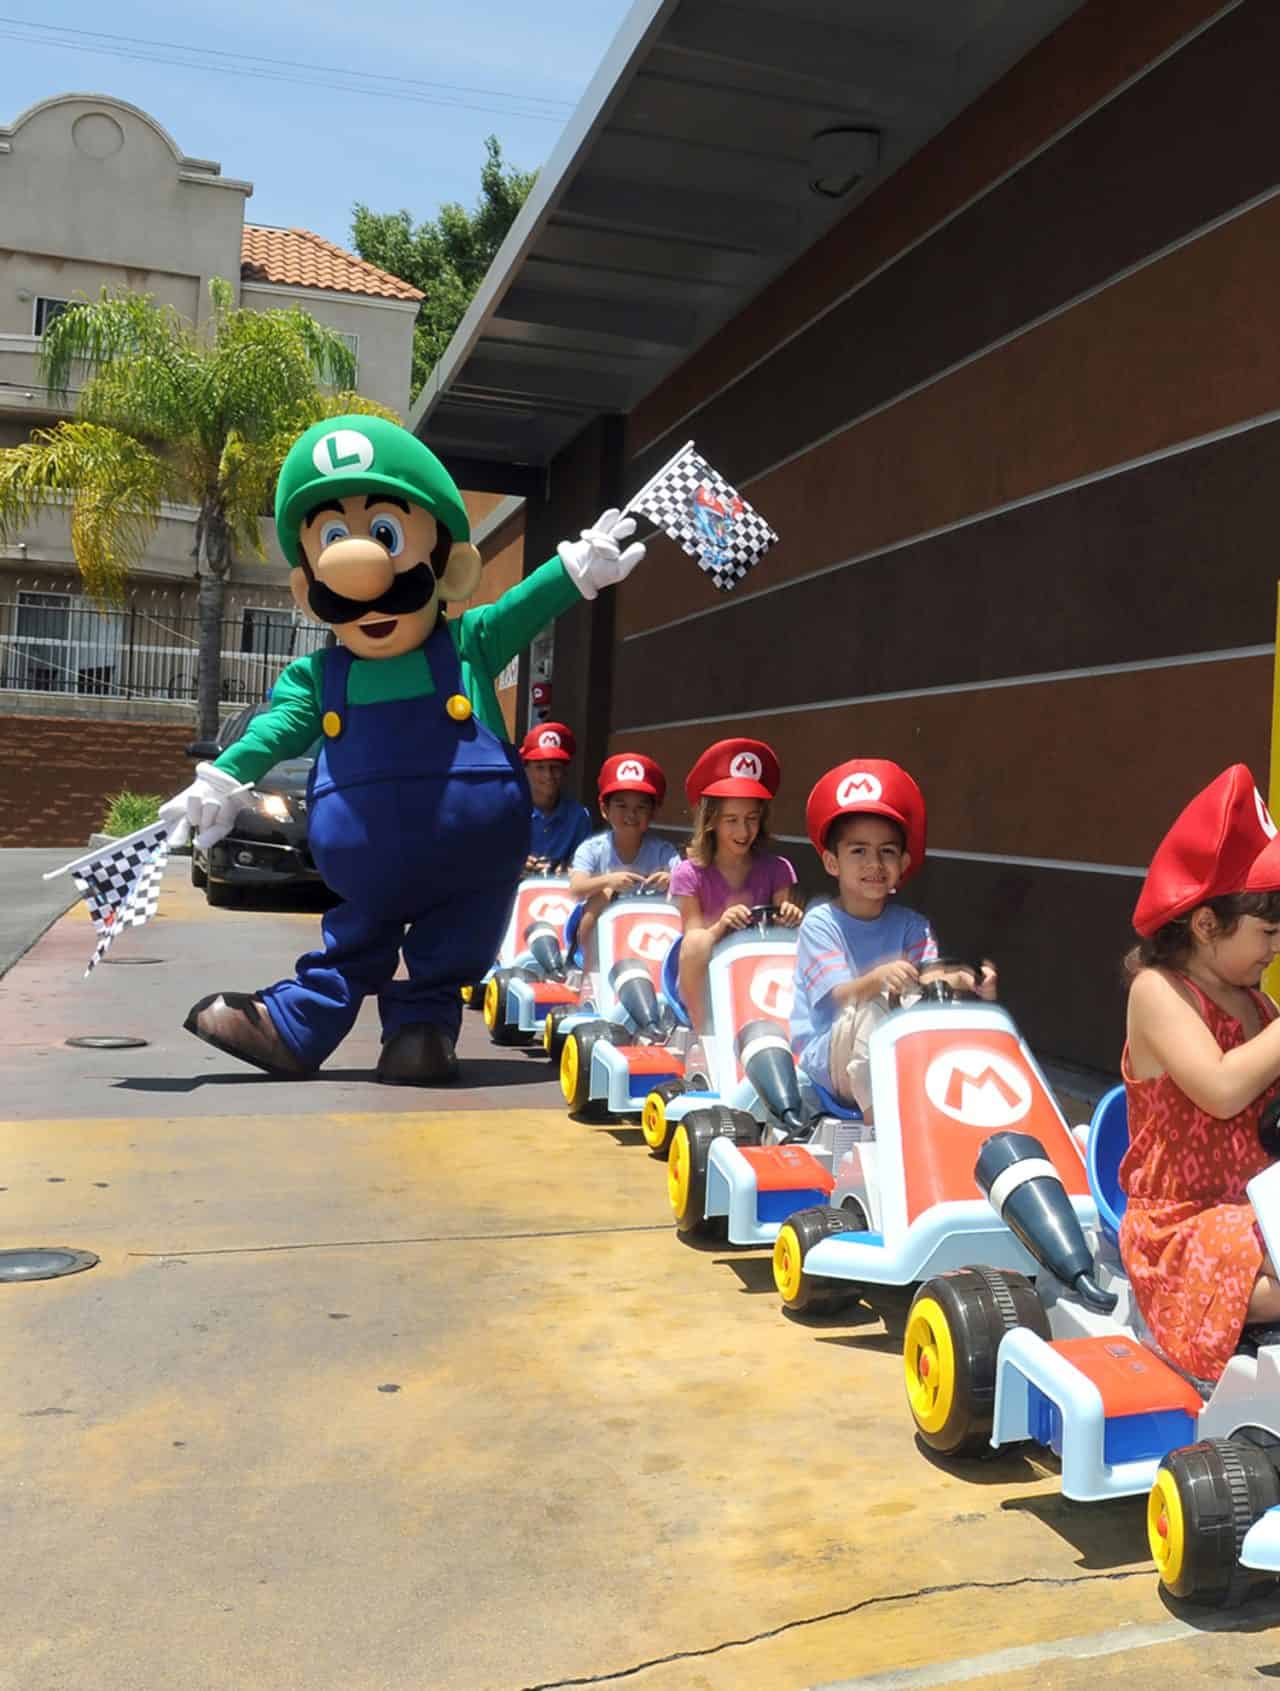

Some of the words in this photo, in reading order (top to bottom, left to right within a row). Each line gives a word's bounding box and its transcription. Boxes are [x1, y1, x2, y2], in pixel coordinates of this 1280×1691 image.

[326, 436, 361, 470] L
[620, 764, 640, 776] M
[735, 756, 757, 775] M
[843, 779, 873, 798] M
[943, 1065, 1023, 1111] M
